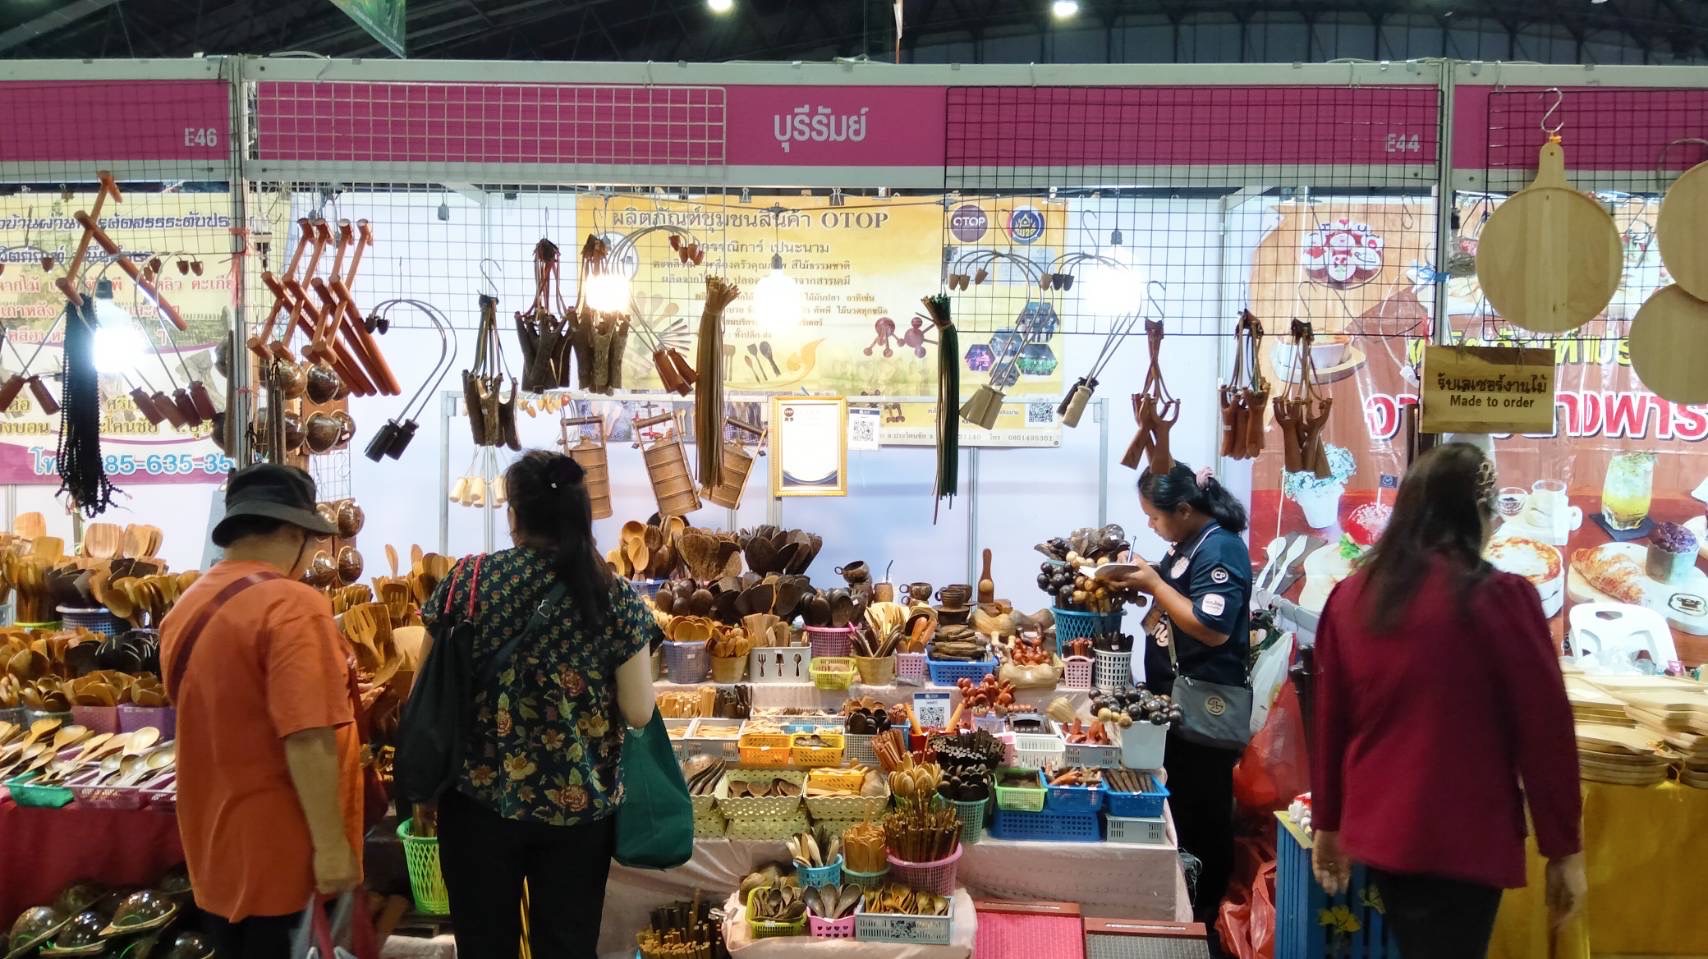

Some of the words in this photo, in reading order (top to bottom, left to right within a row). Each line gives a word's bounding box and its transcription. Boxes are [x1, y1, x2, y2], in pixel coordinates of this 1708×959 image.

[184, 127, 218, 147] E46
[773, 104, 870, 153] บุรีรัมย์
[1387, 133, 1421, 153] E44
[821, 212, 888, 229] OTOP
[953, 216, 986, 227] OTOP
[1450, 395, 1482, 407] Made
[1487, 397, 1499, 407] to
[1503, 397, 1534, 408] order
